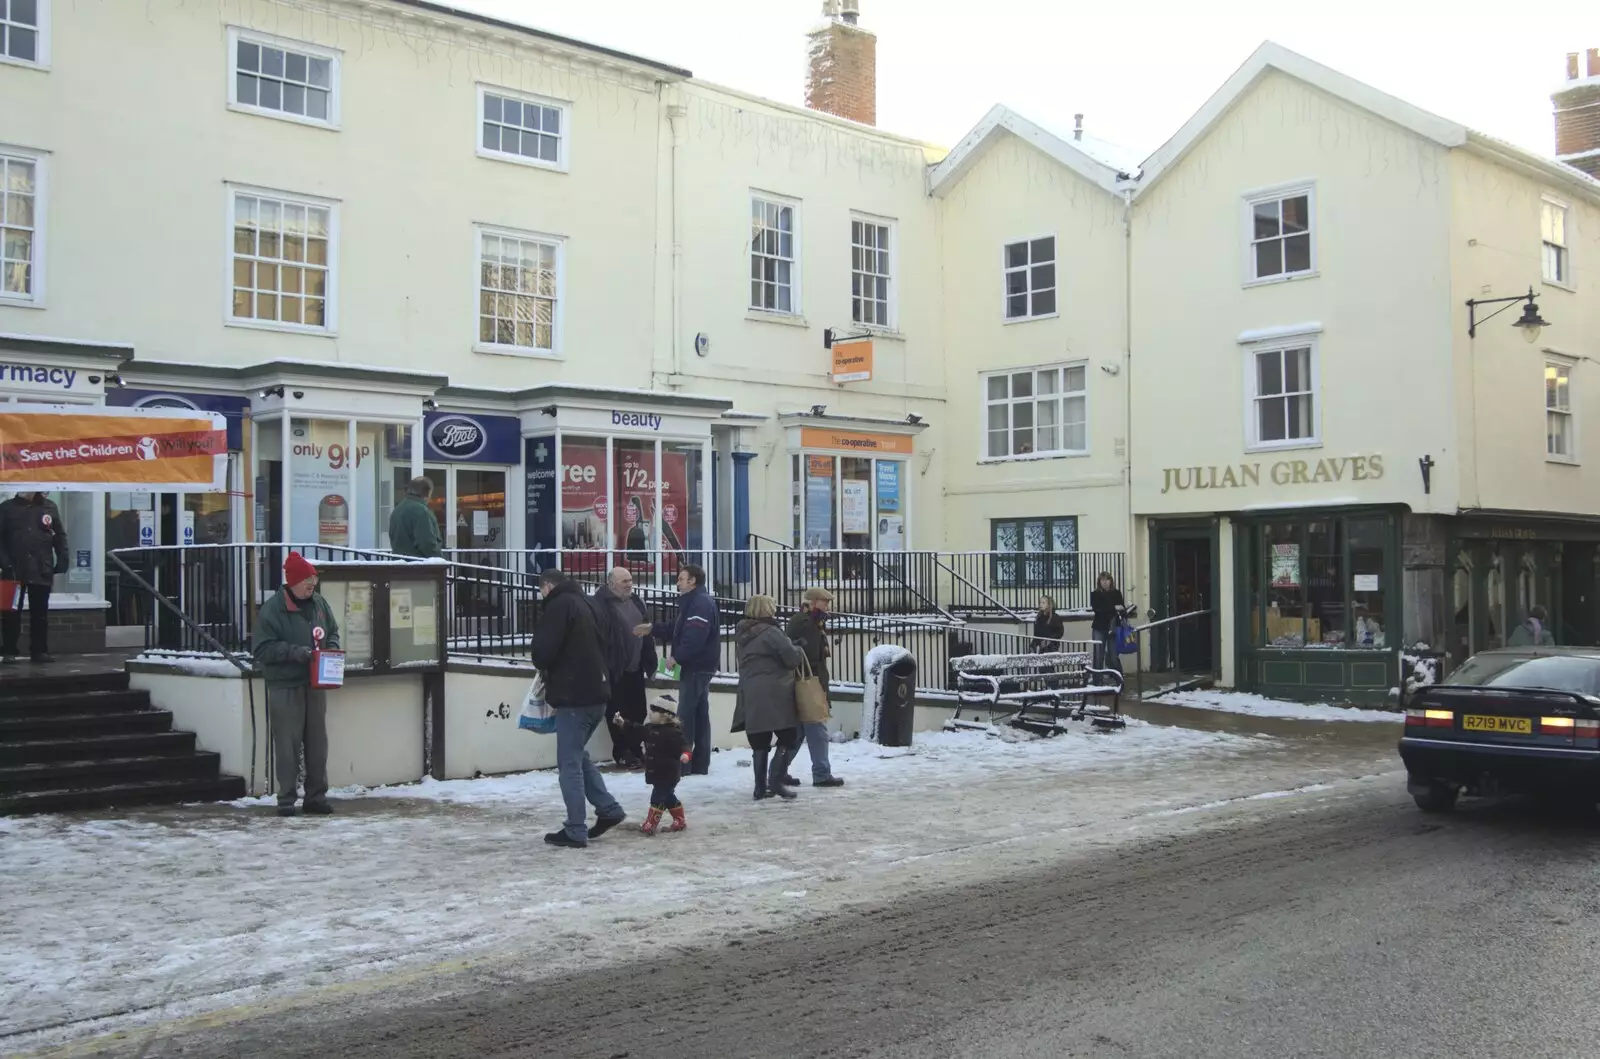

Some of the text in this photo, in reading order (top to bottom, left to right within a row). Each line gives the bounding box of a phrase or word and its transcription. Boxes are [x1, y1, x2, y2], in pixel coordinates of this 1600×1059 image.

[612, 410, 661, 430] beauty
[439, 424, 478, 448] Boots
[841, 438, 877, 448] co-operative
[20, 449, 53, 462] Save
[54, 446, 77, 458] the
[78, 443, 133, 458] Children
[293, 443, 323, 459] only
[527, 469, 555, 480] welcome
[623, 468, 648, 488] 1/2
[1161, 455, 1384, 494] JULIAN GRAVES
[1467, 716, 1526, 731] R719 MVC
